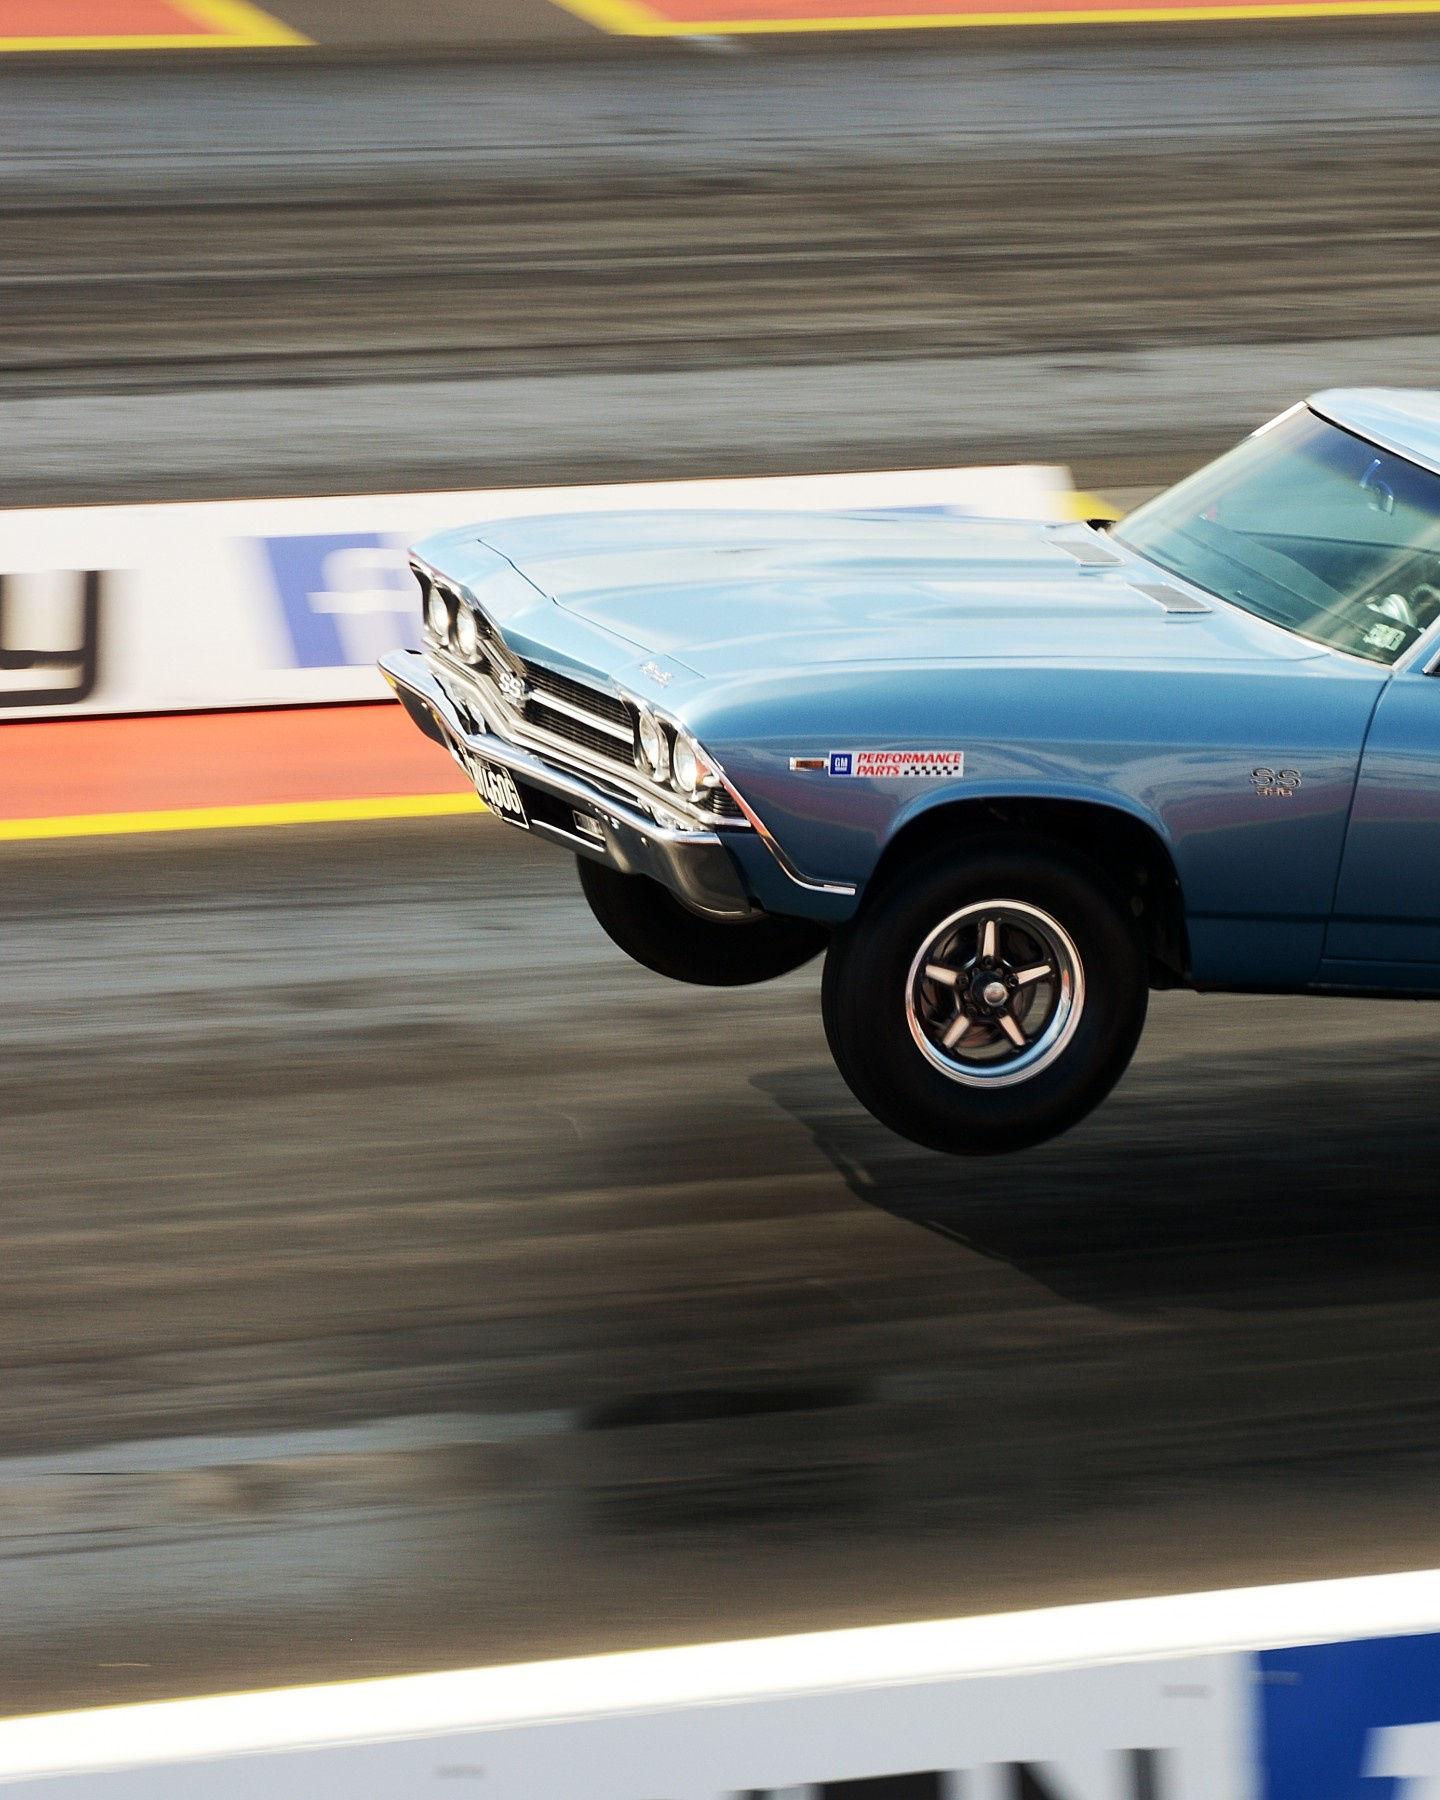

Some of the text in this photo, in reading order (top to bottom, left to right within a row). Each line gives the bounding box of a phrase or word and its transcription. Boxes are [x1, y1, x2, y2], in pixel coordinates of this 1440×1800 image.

[834, 757, 848, 767] GM
[857, 753, 961, 764] PERFORMANCE
[857, 766, 899, 776] PARTS
[1250, 767, 1302, 788] SS
